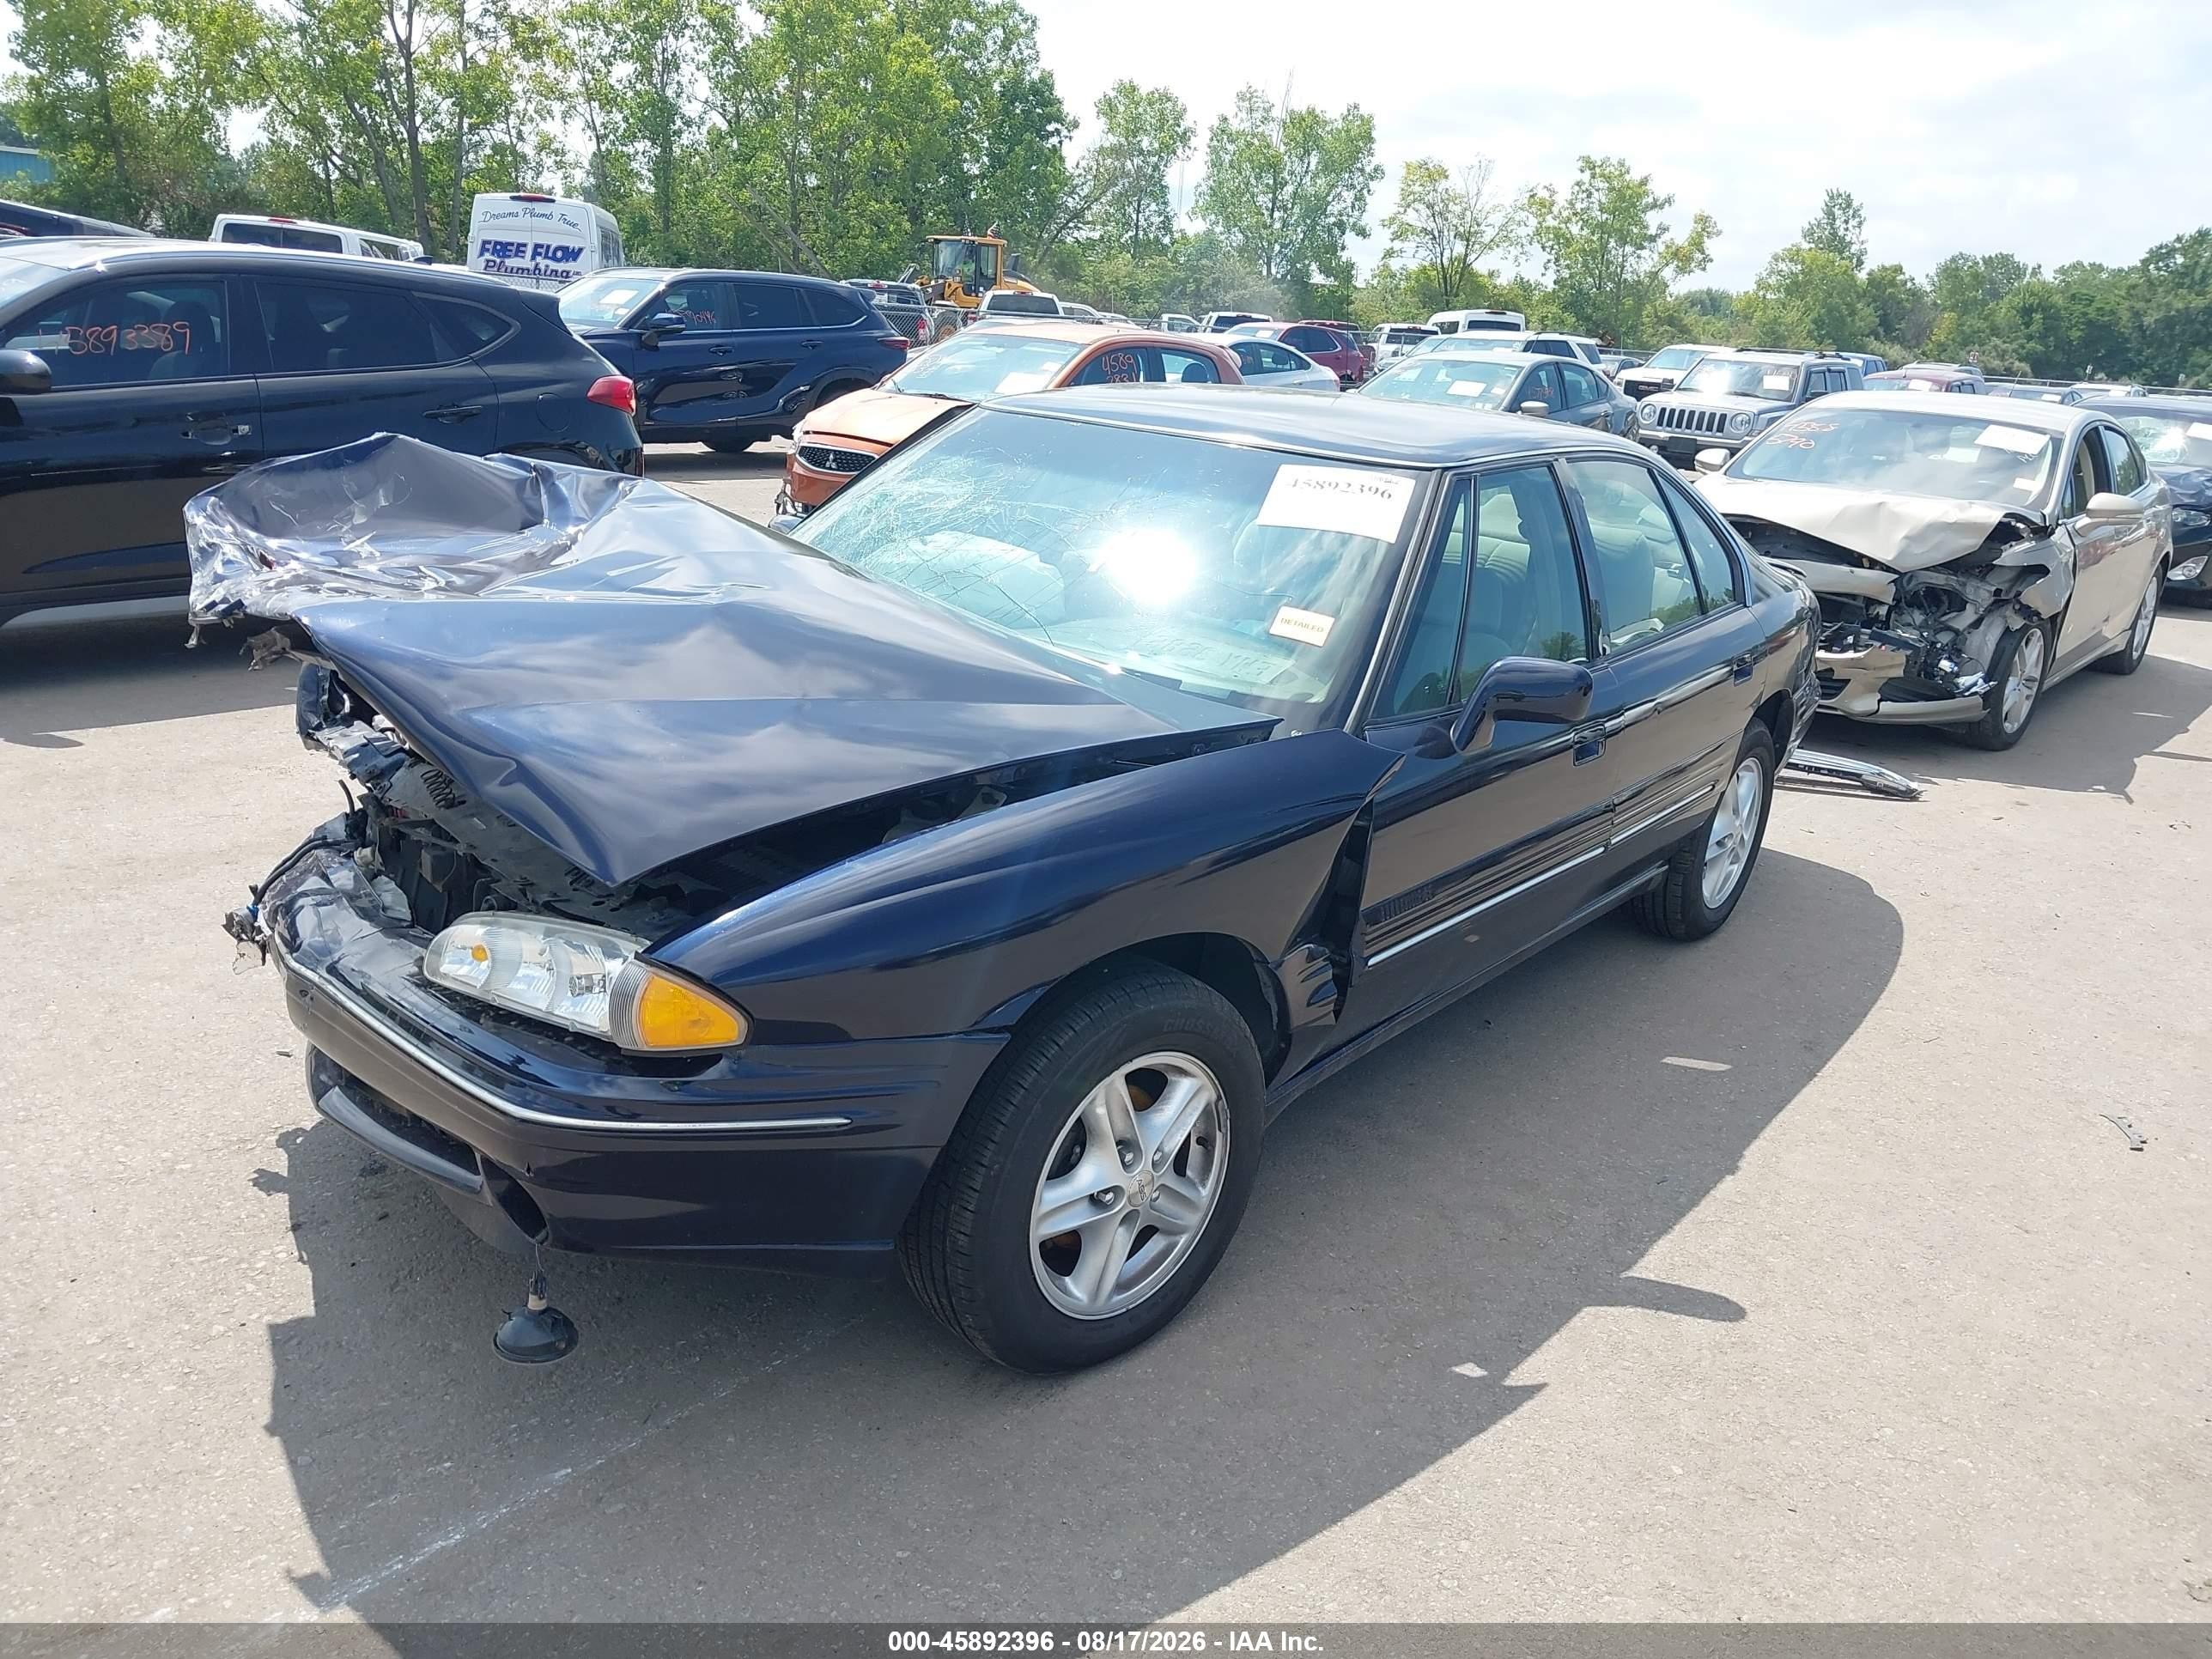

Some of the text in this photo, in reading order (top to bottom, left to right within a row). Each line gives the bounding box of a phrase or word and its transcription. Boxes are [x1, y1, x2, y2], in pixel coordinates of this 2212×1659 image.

[478, 207, 582, 232] Dreams Plumb True
[477, 239, 586, 264] FREE FLOW
[483, 258, 573, 279] Plumbing
[1102, 353, 1138, 374] 4589
[1280, 617, 1324, 633] DETAILED
[1136, 1179, 1147, 1201] ABS
